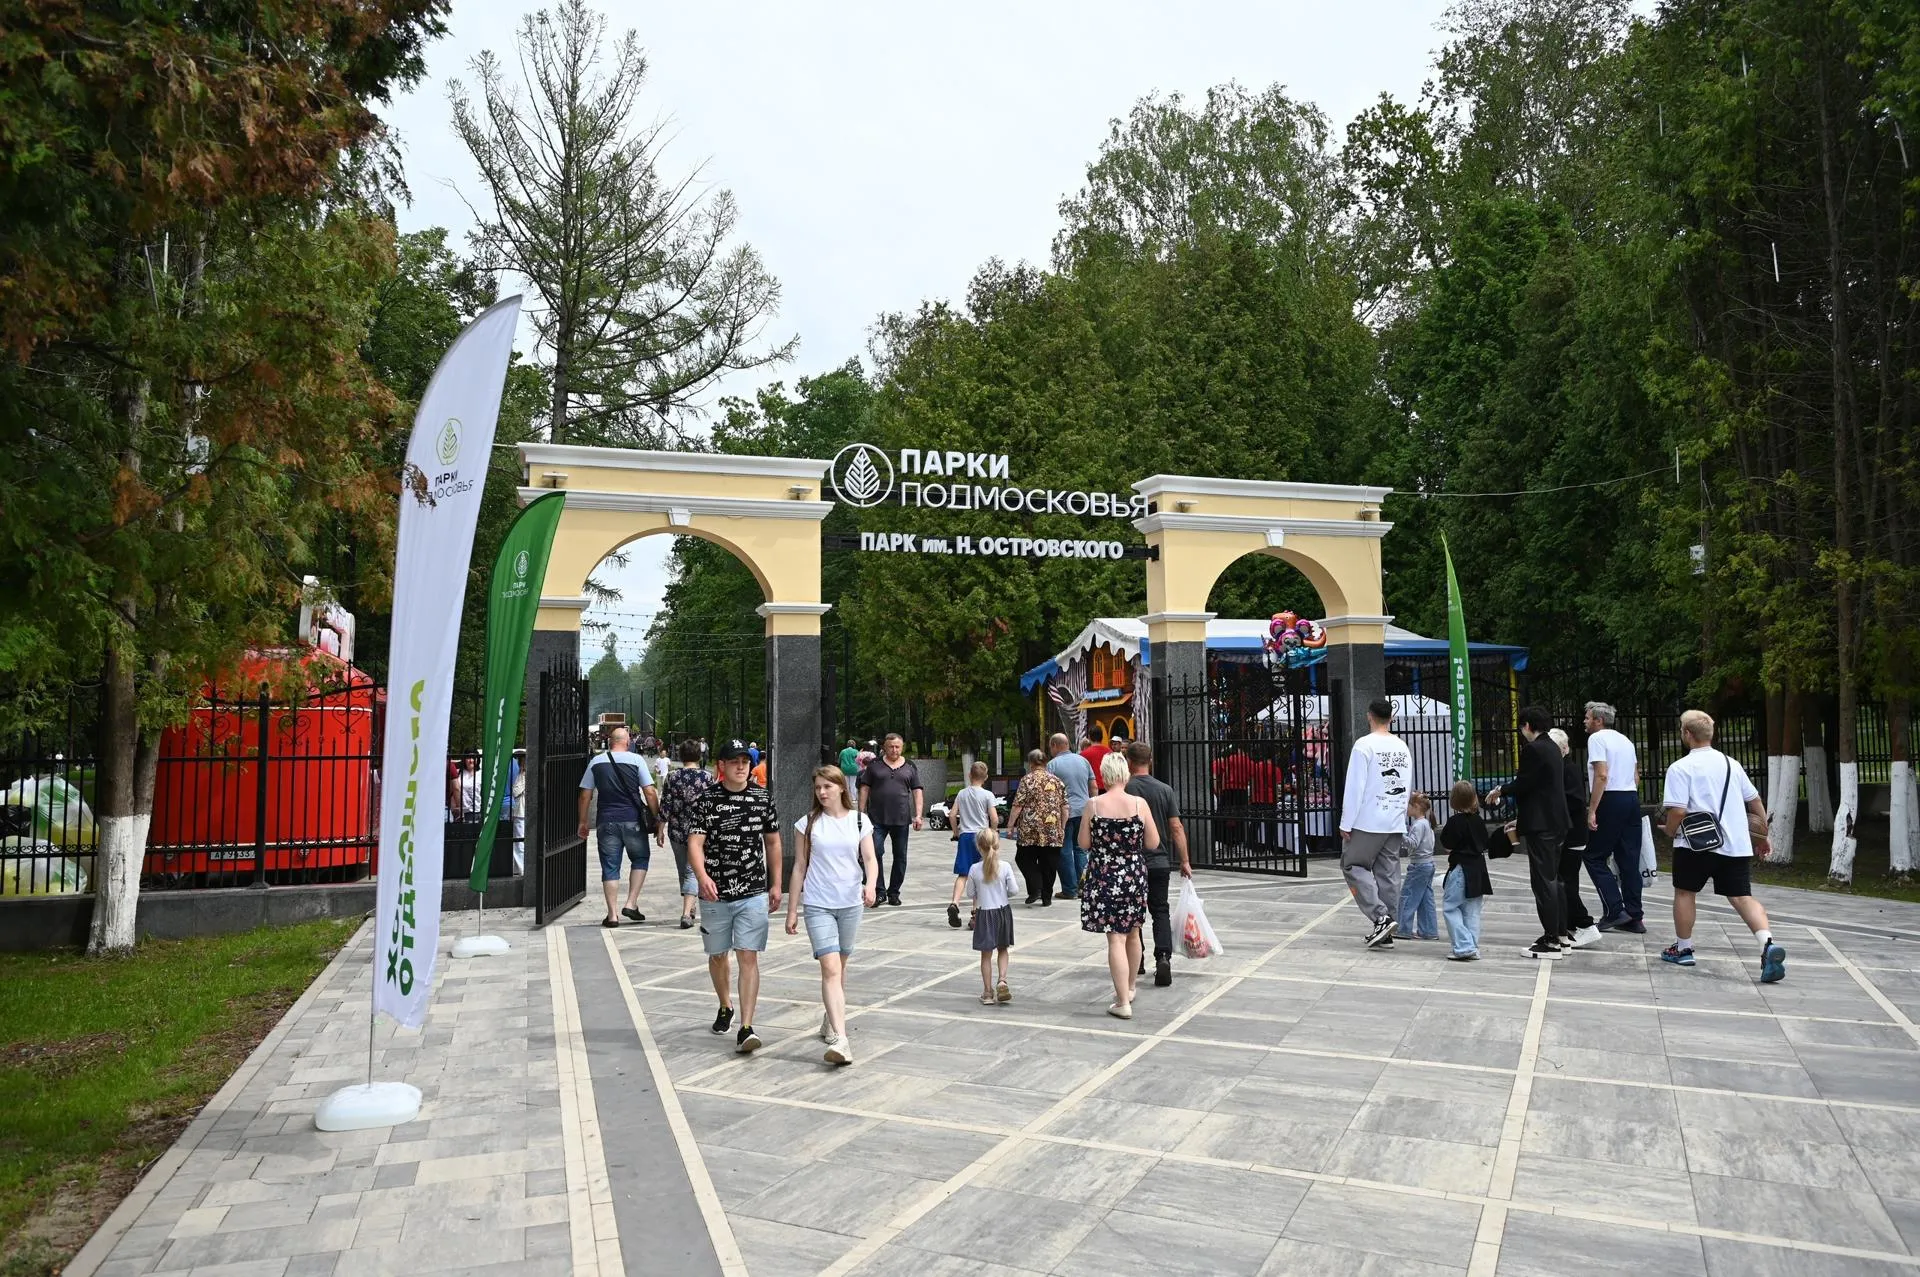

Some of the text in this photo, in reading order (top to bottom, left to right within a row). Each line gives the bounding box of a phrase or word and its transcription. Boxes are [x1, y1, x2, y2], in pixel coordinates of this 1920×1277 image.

[901, 448, 1009, 480] ПАРКИ
[901, 481, 1149, 519] ПОДМОСКОВЬЯ
[860, 531, 1124, 560] ПАРК им. Н. ОСТРОВСКОГО
